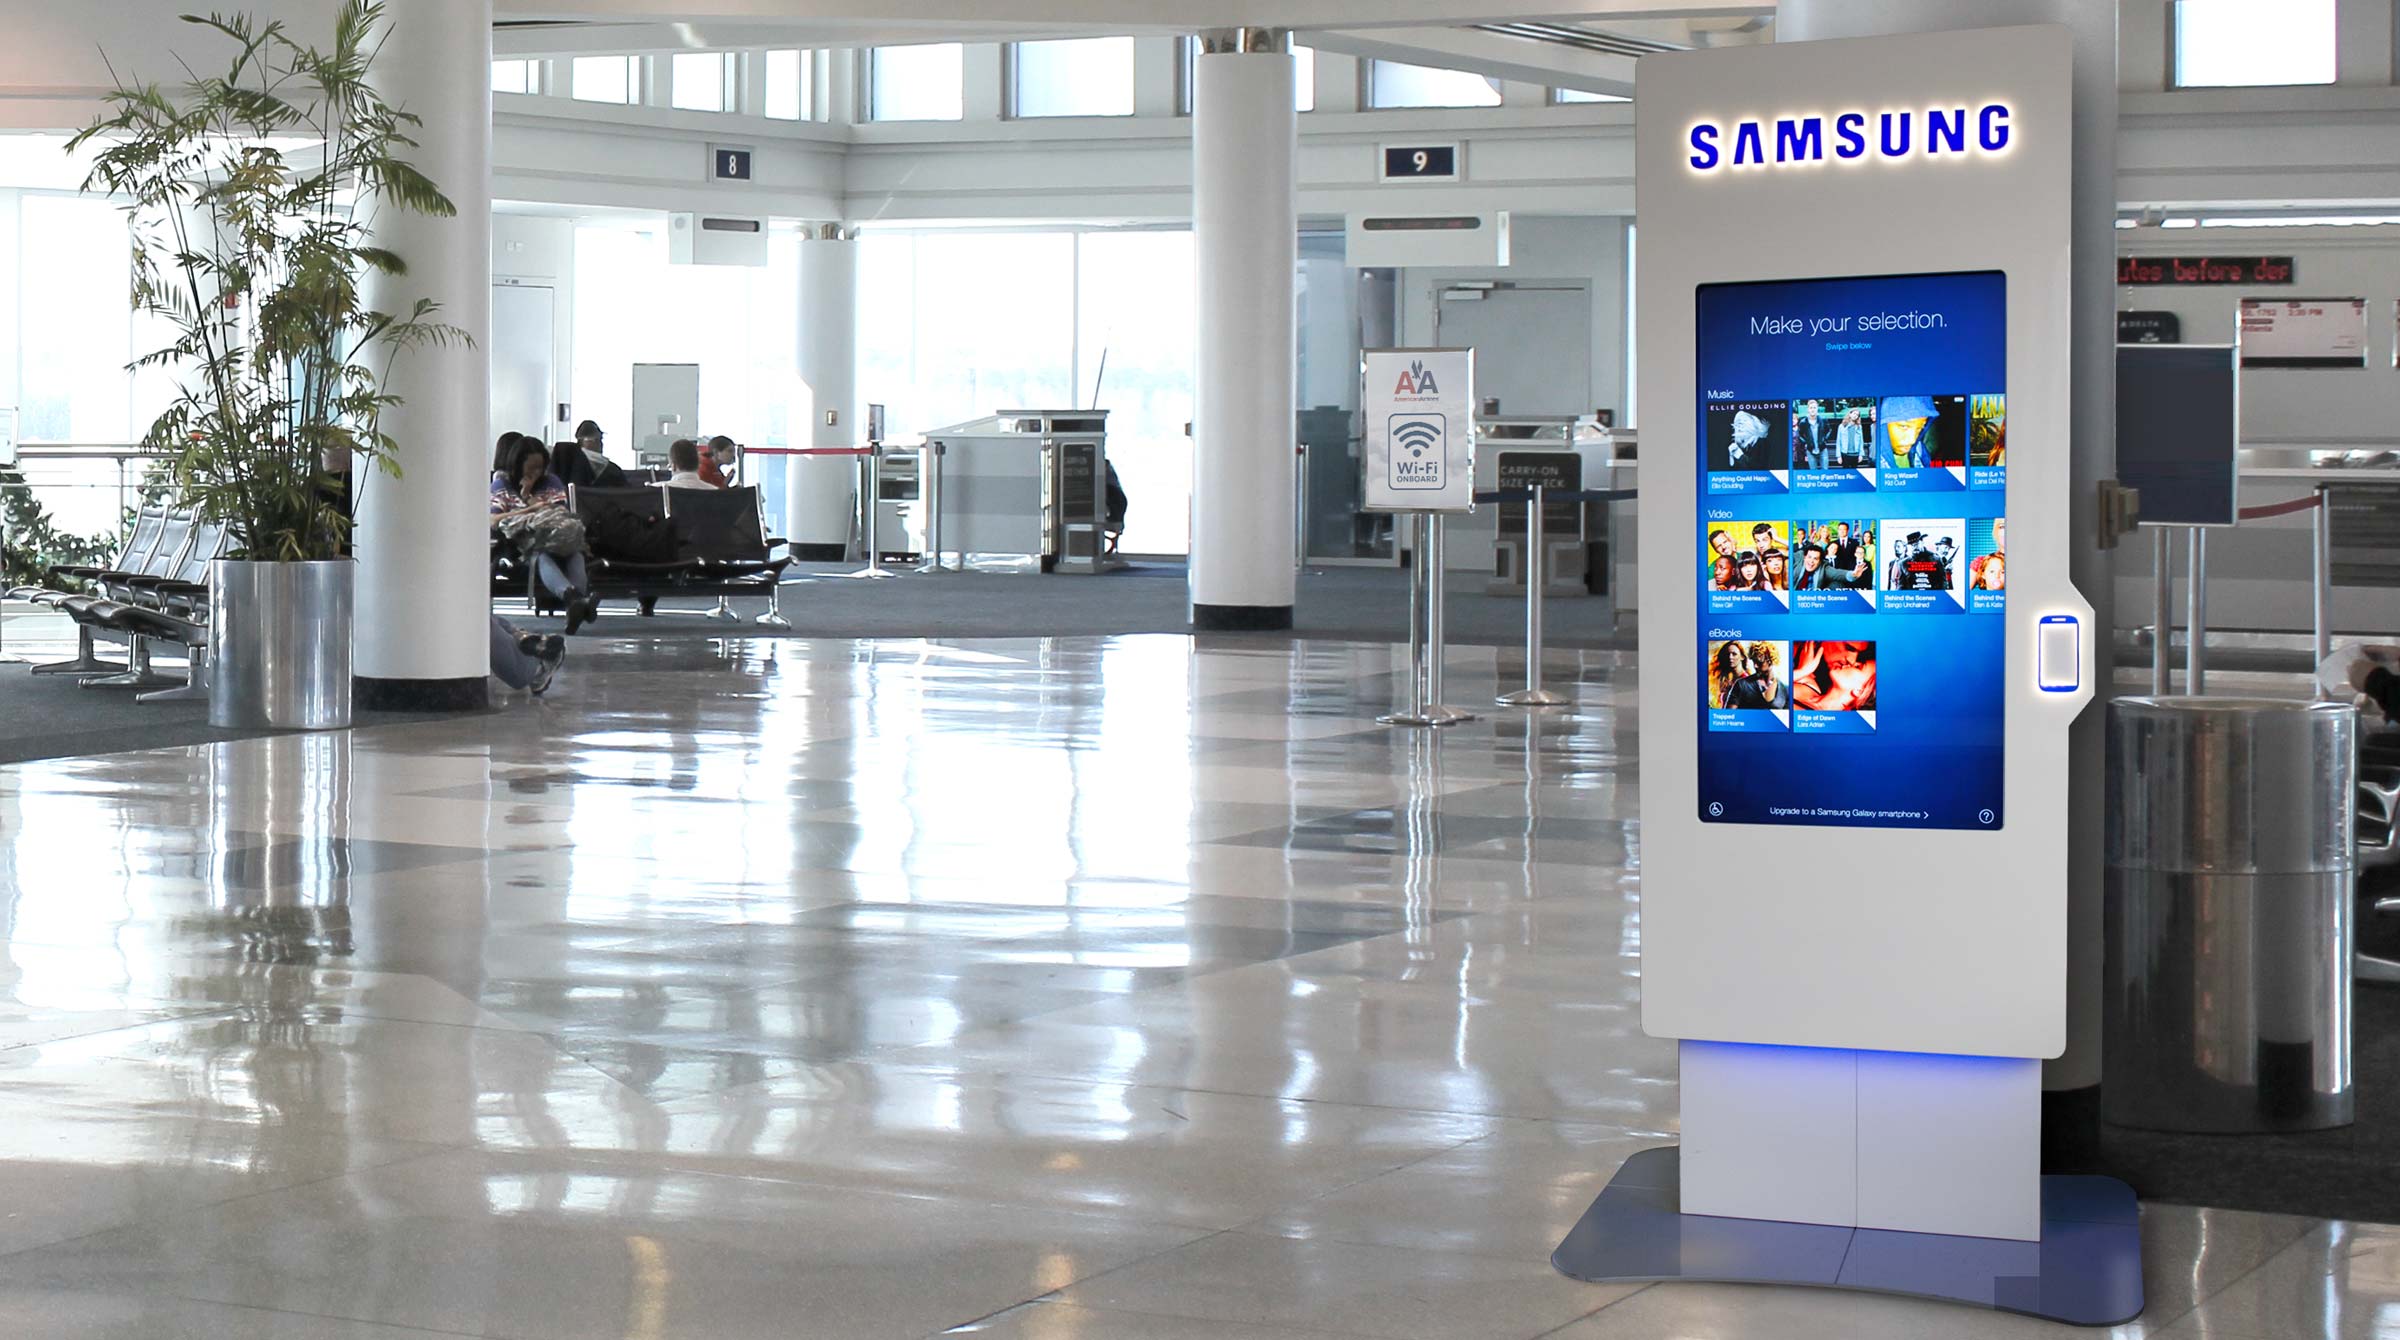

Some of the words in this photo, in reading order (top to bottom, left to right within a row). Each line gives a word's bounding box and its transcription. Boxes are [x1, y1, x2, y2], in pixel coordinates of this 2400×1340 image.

[1690, 104, 2010, 170] SAMSUNG
[729, 154, 737, 175] 8
[1413, 151, 1428, 172] 9
[2173, 257, 2241, 281] before
[1750, 316, 1804, 335] Make
[1809, 317, 1852, 337] your
[1857, 310, 1948, 332] selection.
[1825, 342, 1849, 350] Swipe
[1849, 341, 1873, 350] below
[1707, 389, 1735, 399] Music
[1738, 402, 1786, 411] GOULDING
[1397, 461, 1438, 474] Wi-Fi
[1501, 465, 1559, 476] CARRY-ON
[1396, 475, 1438, 483] ONBOARD
[1707, 509, 1733, 519] Video
[1708, 628, 1743, 638] eBooks
[1769, 807, 1800, 816] Upgrade
[1816, 808, 1851, 818] Samsung
[1852, 808, 1877, 818] Galaxy
[1877, 809, 1921, 819] smartphone
